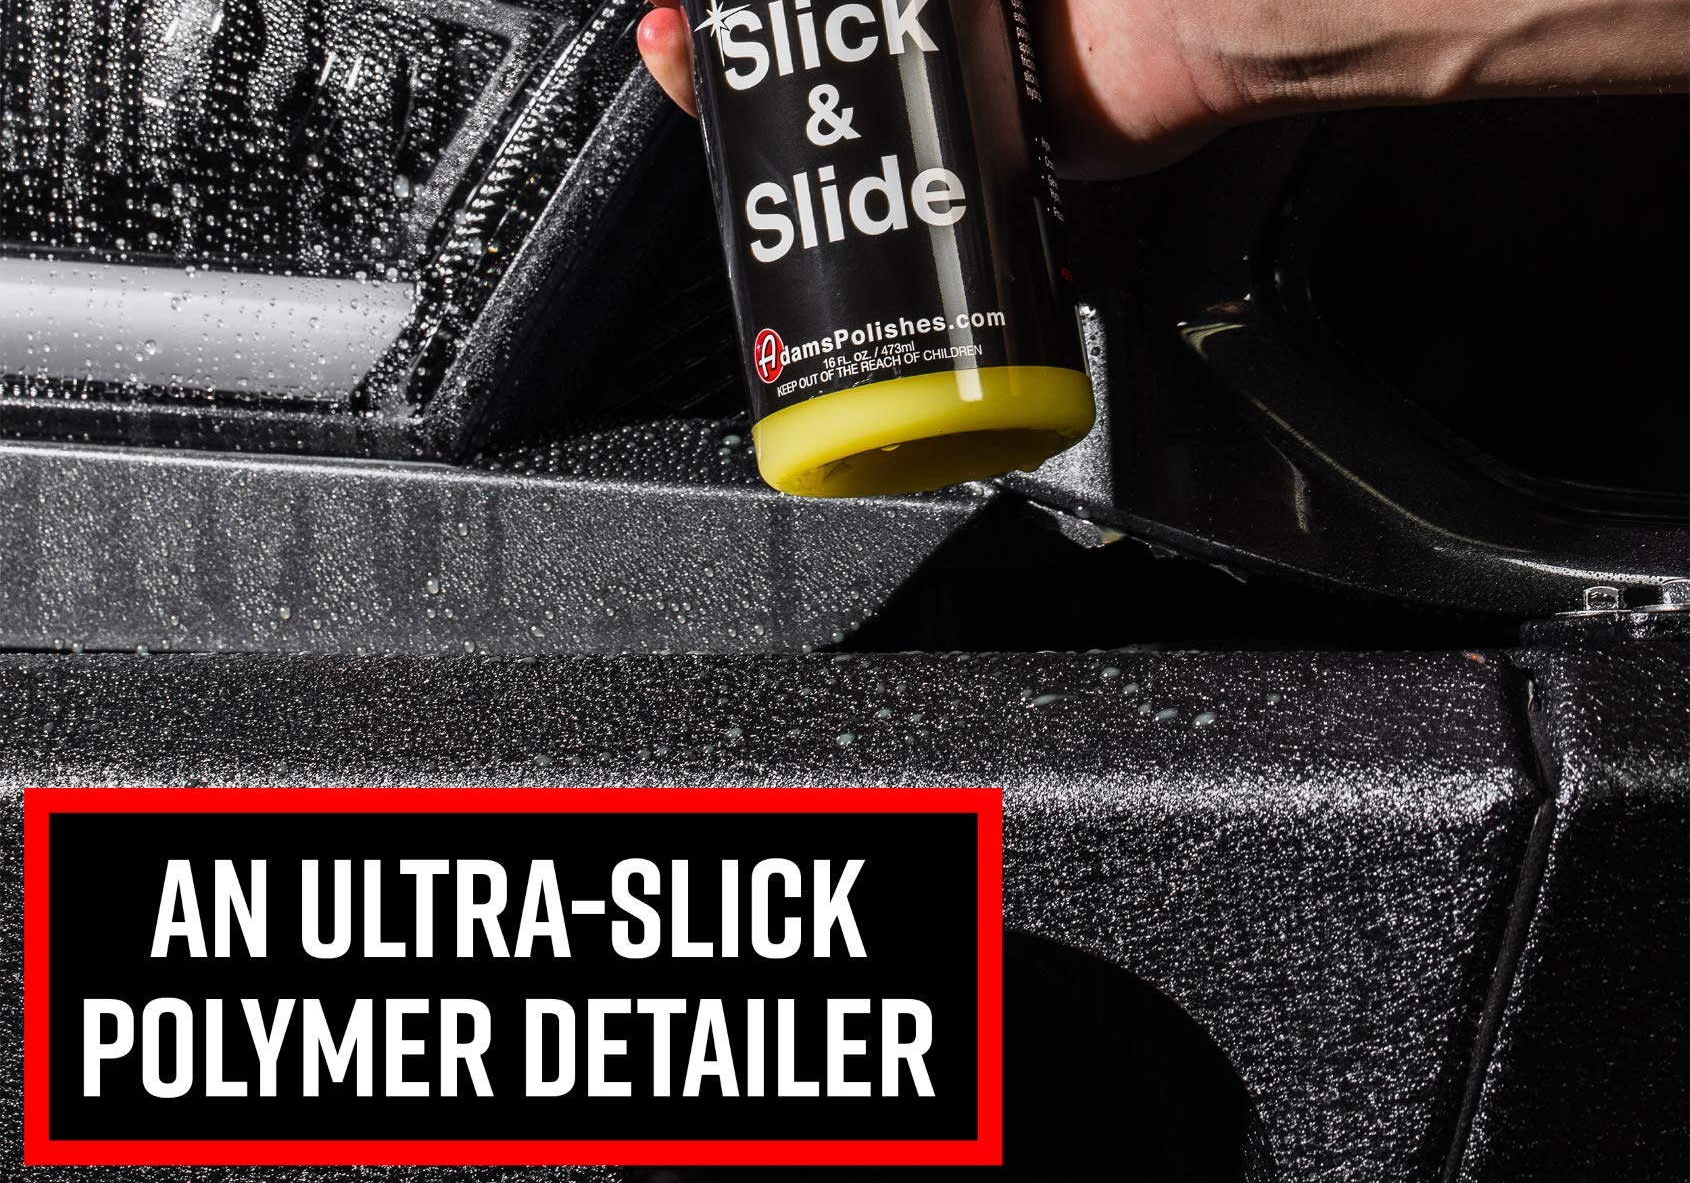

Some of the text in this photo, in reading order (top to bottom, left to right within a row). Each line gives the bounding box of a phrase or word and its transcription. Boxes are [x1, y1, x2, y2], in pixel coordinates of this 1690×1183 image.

[805, 83, 862, 147] &
[745, 154, 967, 263] Slide
[757, 310, 1006, 379] AdamsPolishes.com
[777, 344, 983, 398] KEEP OUT OF THE REACH OF CHILDREN
[822, 356, 837, 370] 16
[837, 354, 852, 367] FL.
[874, 346, 879, 358] /
[881, 341, 916, 356] 473ml
